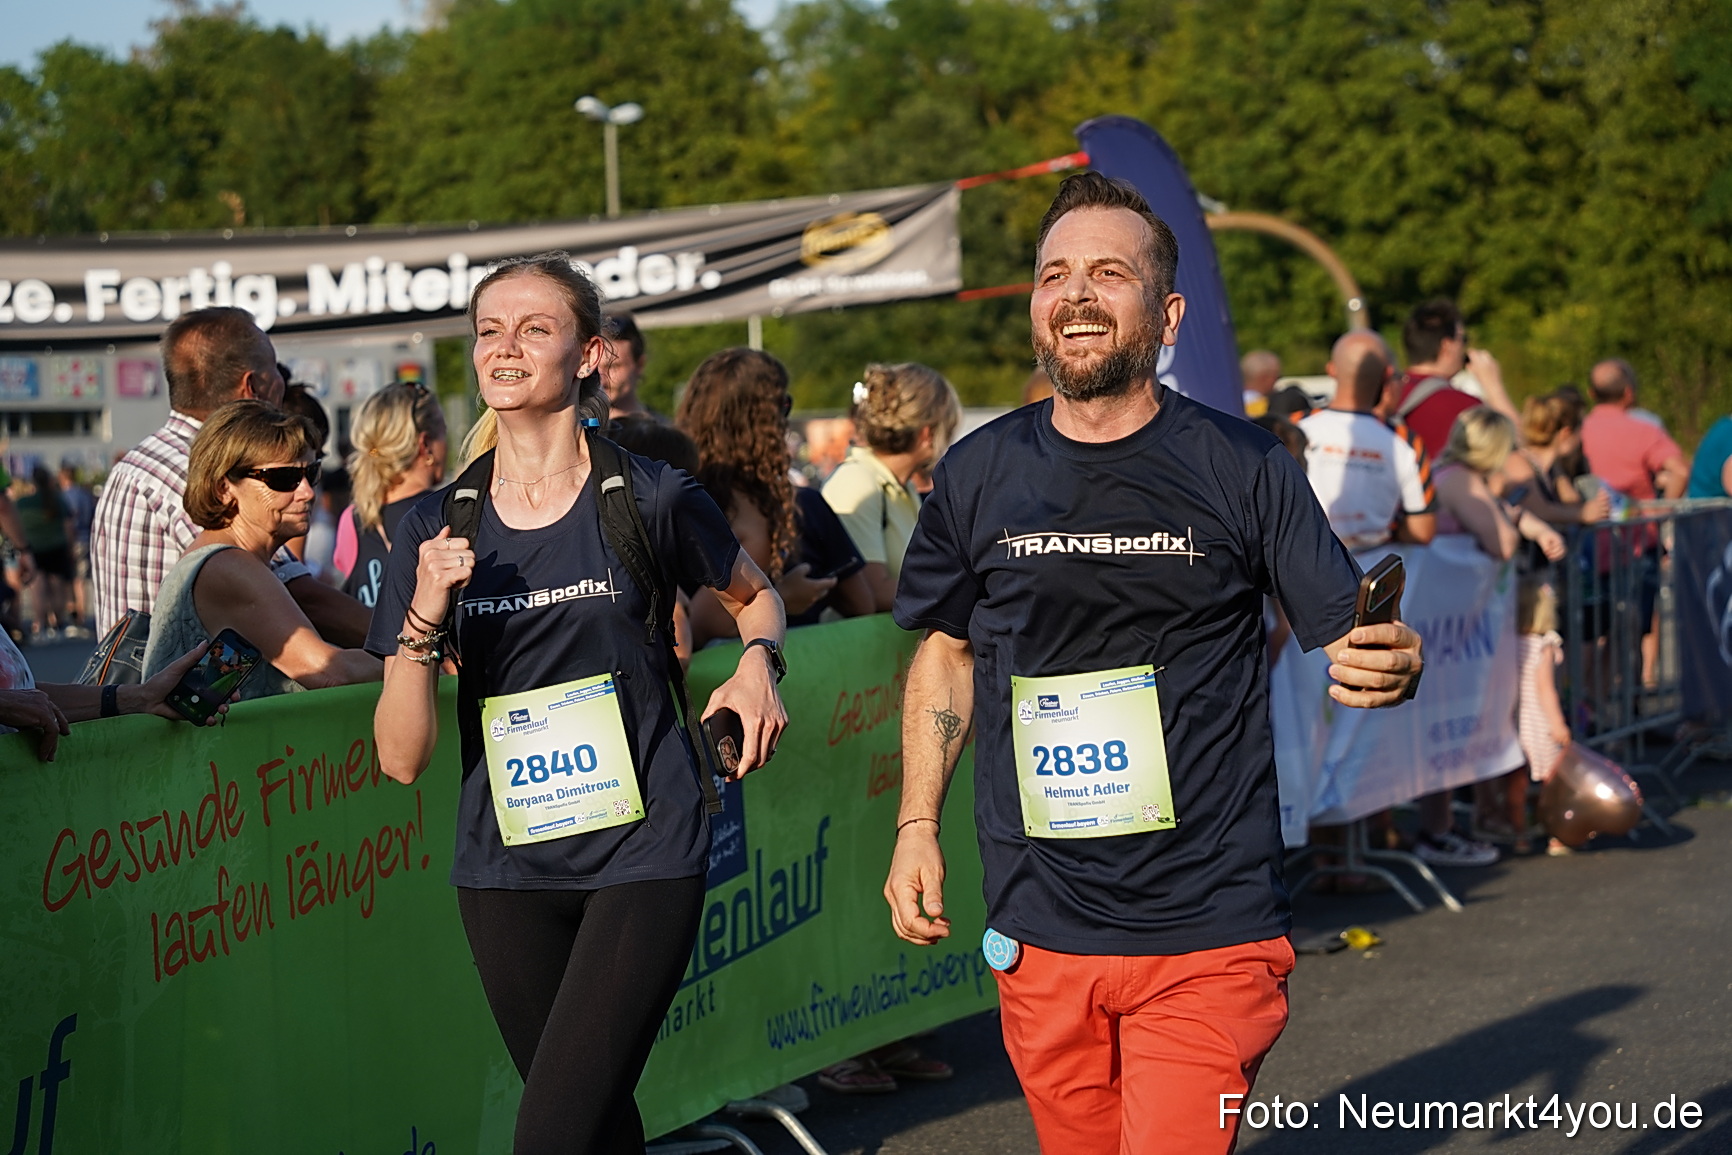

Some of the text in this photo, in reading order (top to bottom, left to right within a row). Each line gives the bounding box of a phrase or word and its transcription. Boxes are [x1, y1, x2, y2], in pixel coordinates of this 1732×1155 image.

[84, 260, 298, 332] Fertig.
[307, 246, 722, 314] Miteider.
[1011, 532, 1187, 557] TRANSpofix
[464, 578, 609, 617] TRANSpofix
[506, 716, 548, 735] Firmenlauf
[1034, 706, 1079, 720] Firmenlauf
[1051, 714, 1079, 723] neumarkt
[506, 744, 598, 787] 2840
[1032, 740, 1129, 776] 2838
[506, 778, 621, 809] Boryana Dimitrova
[1044, 782, 1131, 799] Helmut Adler
[42, 761, 245, 912] Gesunde
[151, 790, 430, 982] laufen länger!
